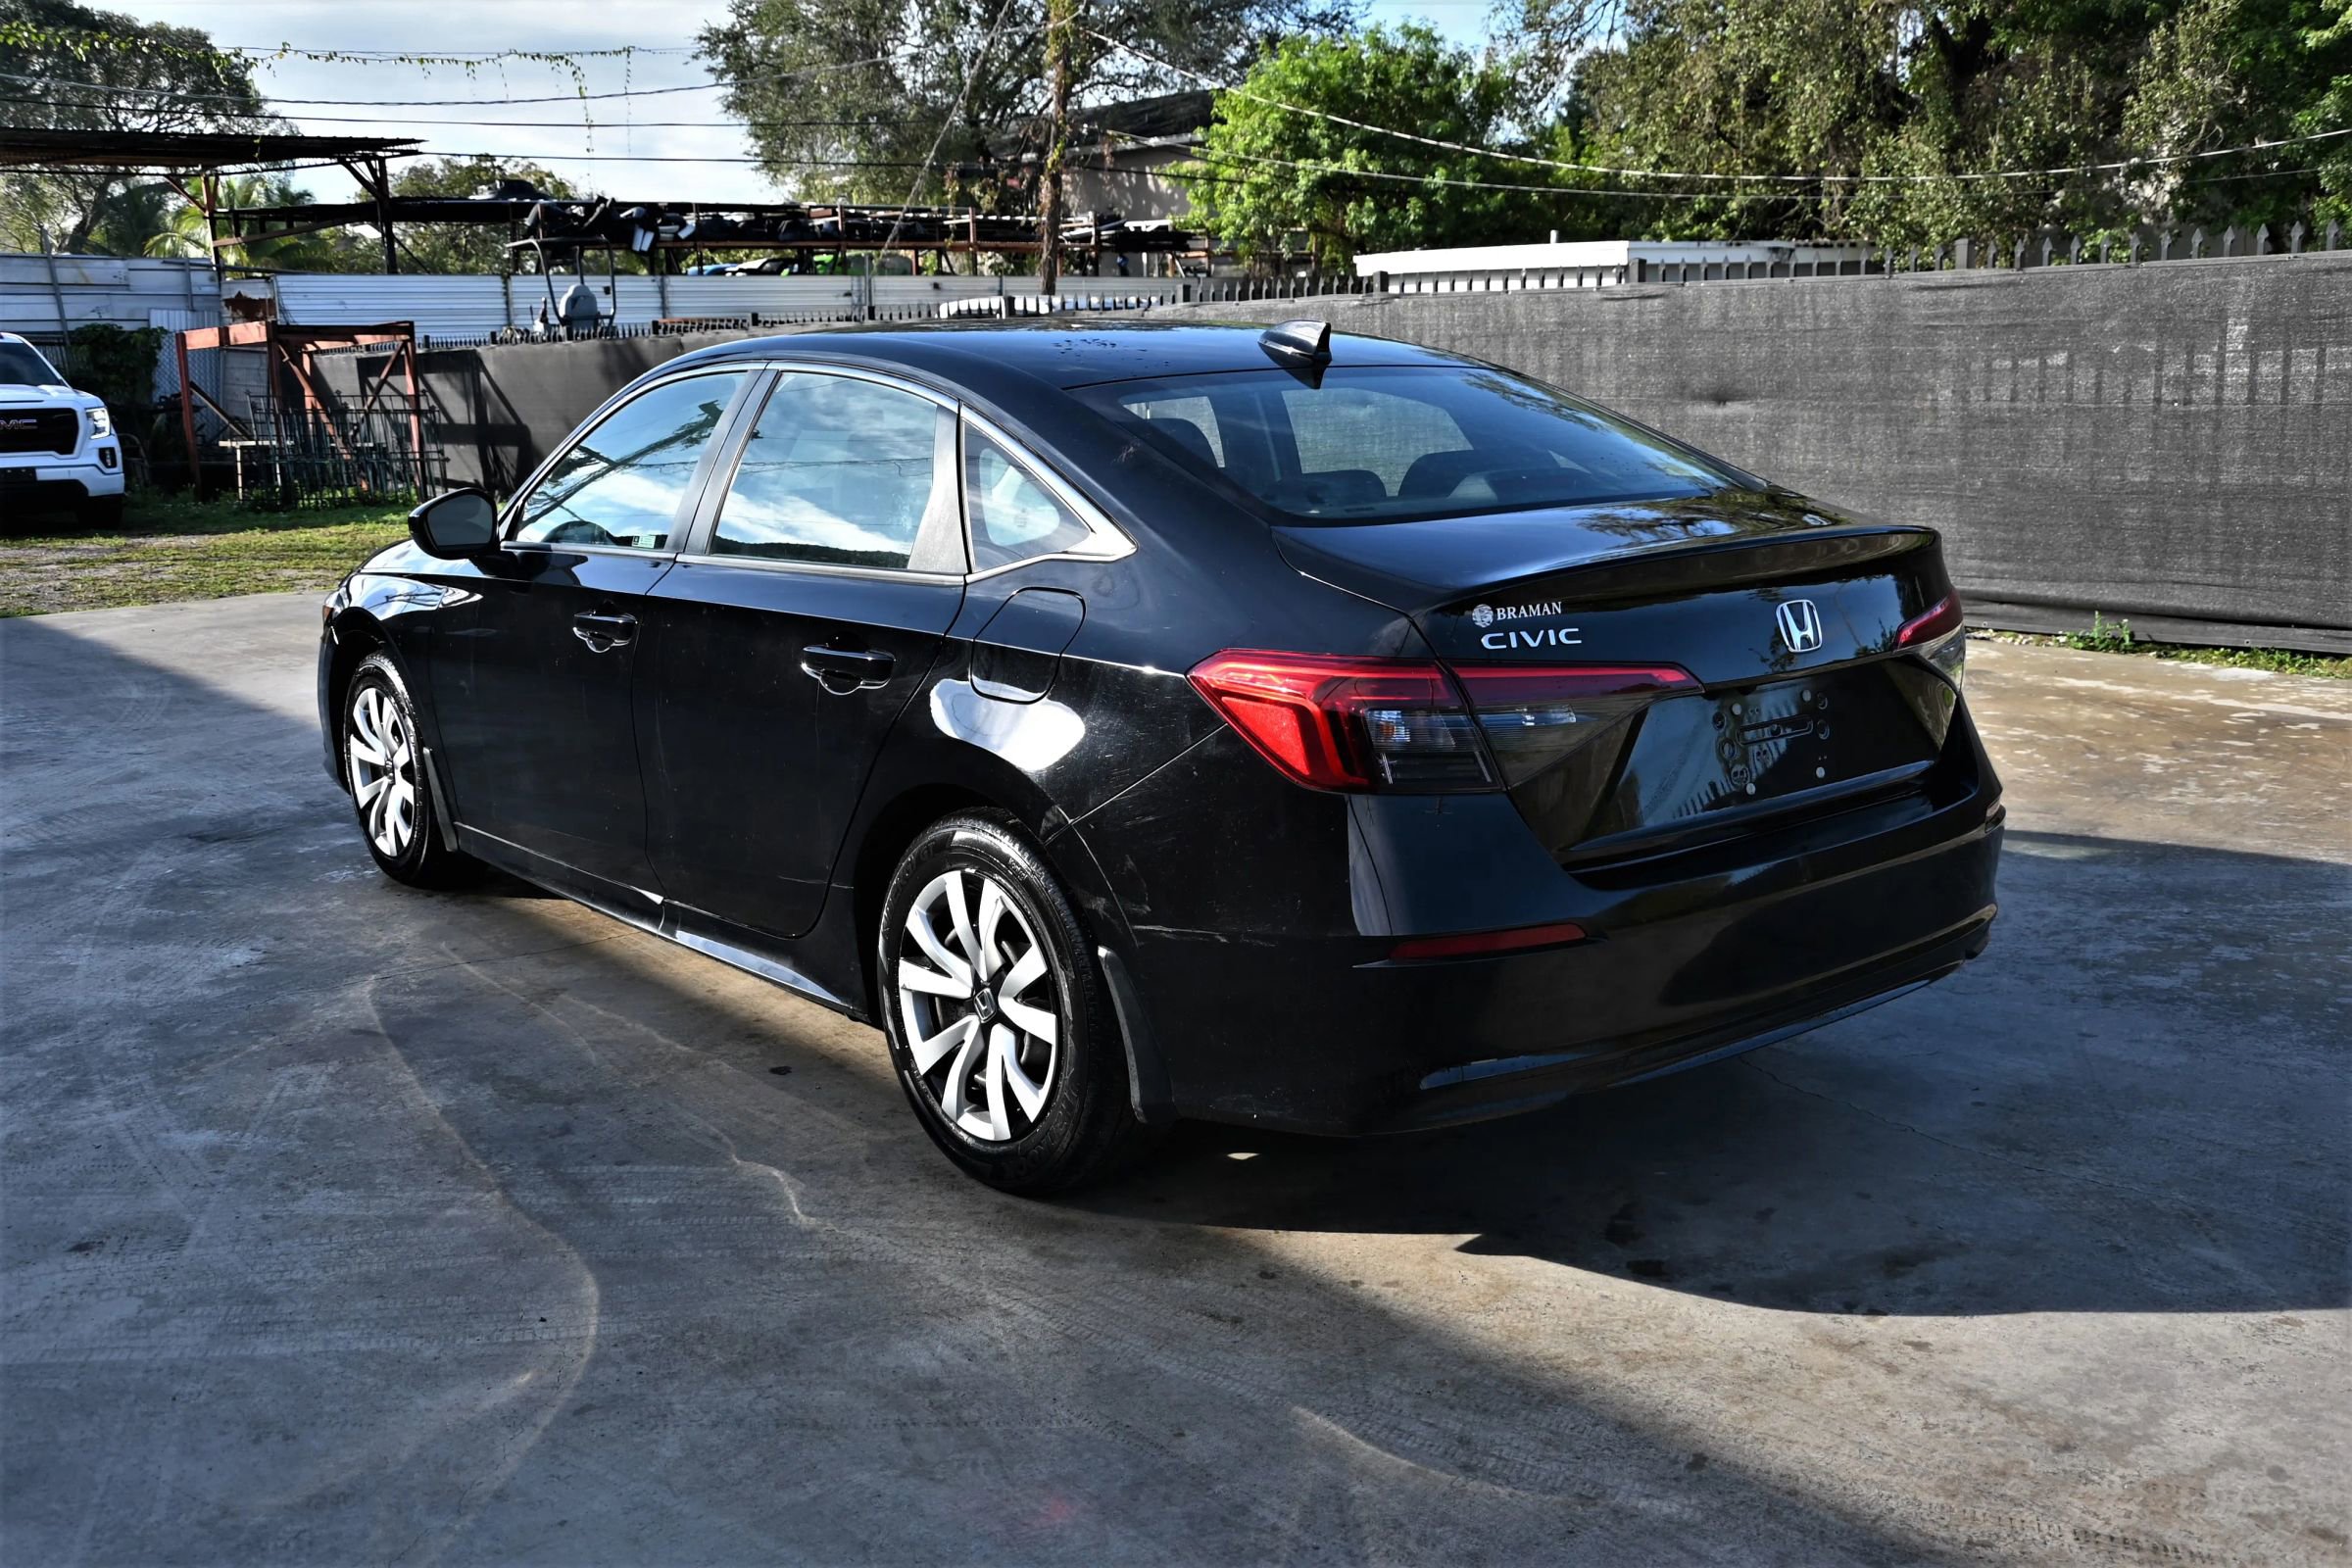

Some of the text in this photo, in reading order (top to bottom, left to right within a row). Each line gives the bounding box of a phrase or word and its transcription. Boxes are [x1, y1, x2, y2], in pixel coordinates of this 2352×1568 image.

[0, 418, 37, 430] MC
[1495, 601, 1562, 620] BRAMAN
[1481, 627, 1582, 650] CIVIC
